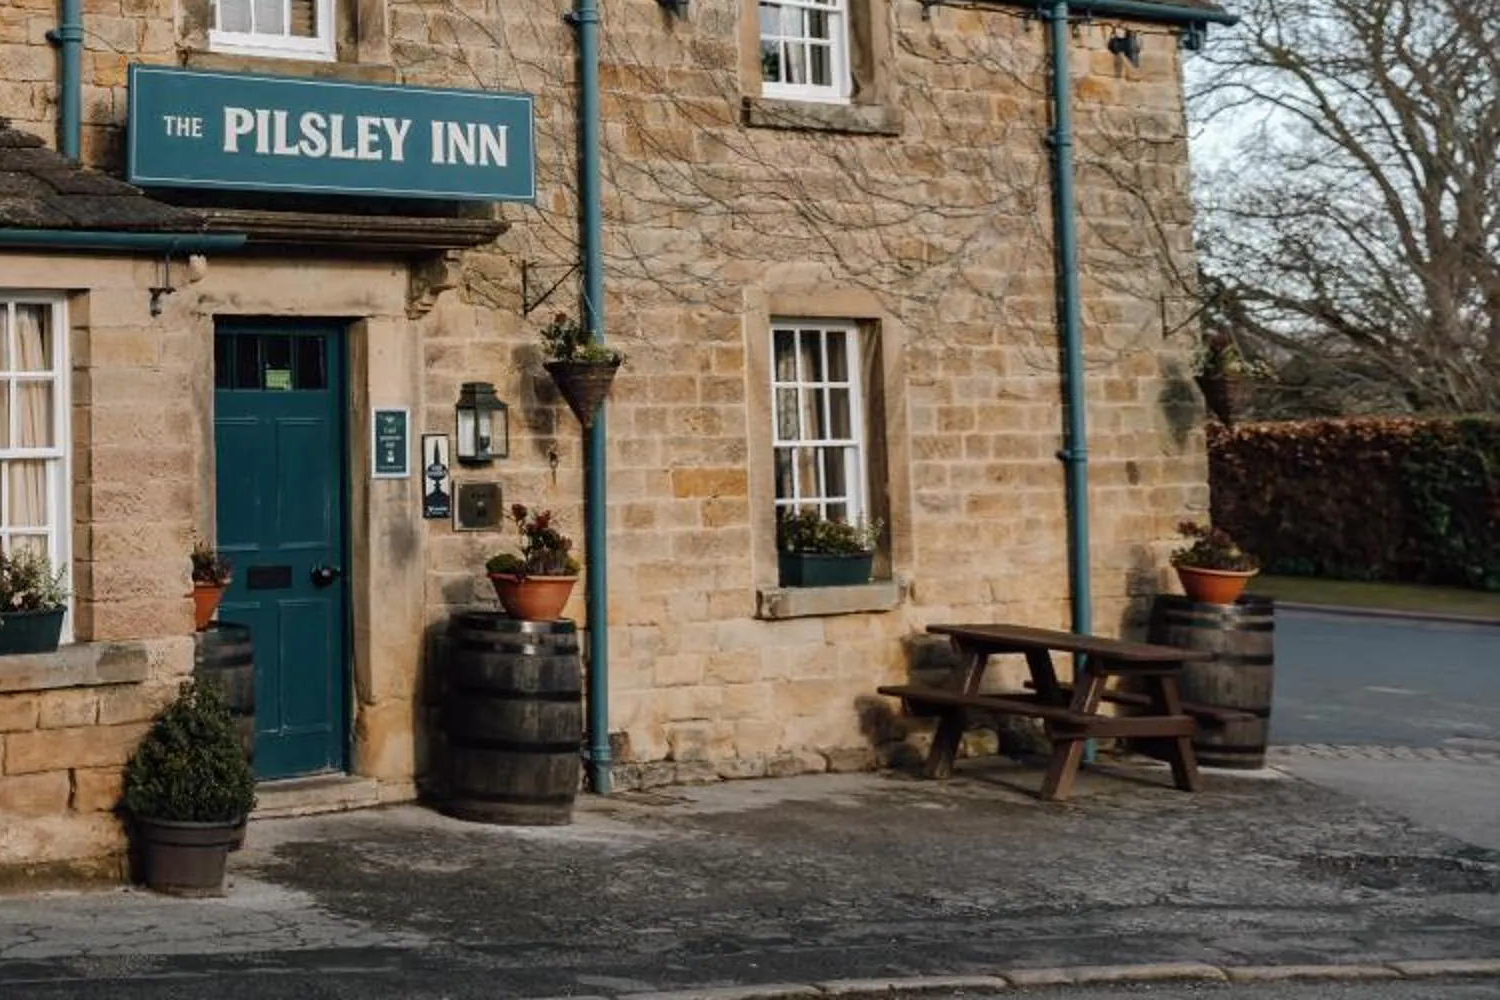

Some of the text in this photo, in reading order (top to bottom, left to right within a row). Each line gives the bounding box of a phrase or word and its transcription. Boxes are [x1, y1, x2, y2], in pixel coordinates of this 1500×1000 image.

[163, 106, 509, 167] THE PILSLEY INN
